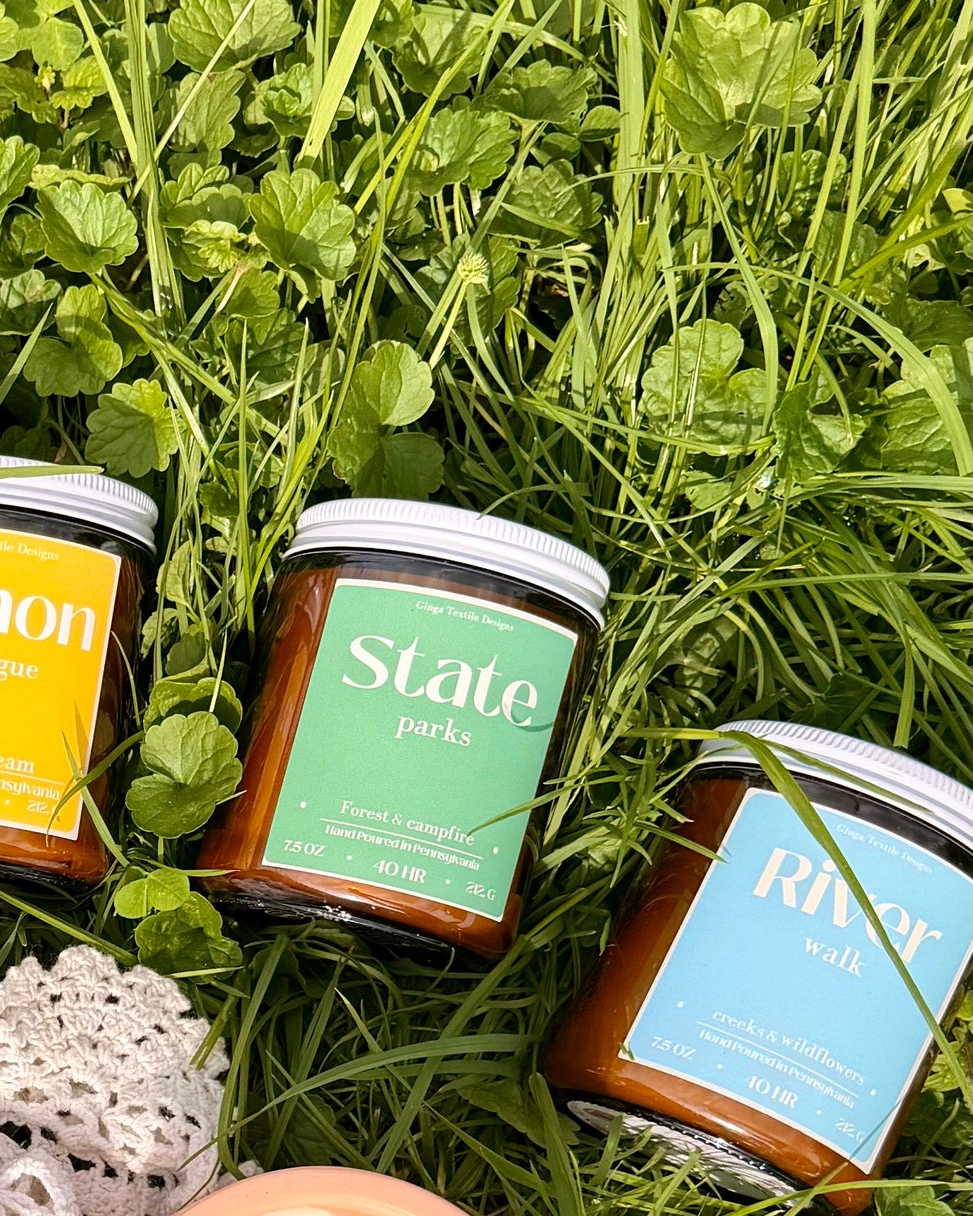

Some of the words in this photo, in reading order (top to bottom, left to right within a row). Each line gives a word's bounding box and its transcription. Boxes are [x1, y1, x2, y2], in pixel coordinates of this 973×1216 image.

[17, 542, 59, 561] Designs
[415, 600, 444, 615] Ginga
[446, 606, 479, 621] Textile
[481, 614, 514, 631] Designs
[341, 635, 538, 727] State
[394, 715, 472, 747] parks
[340, 800, 389, 823] Forest
[391, 813, 403, 826] &
[406, 819, 475, 846] campfire
[868, 835, 899, 856] Textile
[283, 839, 302, 853] 7.5
[303, 843, 326, 857] OZ
[372, 859, 400, 877] 40
[401, 864, 428, 885] HR
[487, 888, 496, 901] G
[324, 824, 357, 841] Hand
[356, 830, 401, 850] Poured
[412, 843, 480, 871] Pennsylvania
[753, 847, 943, 964] River
[804, 936, 866, 978] walk
[699, 1029, 733, 1049] Hand
[731, 1041, 777, 1068] Poured
[787, 1066, 855, 1109] Pennsylvania
[712, 1010, 765, 1038] creeks
[766, 1030, 779, 1043] &
[782, 1033, 866, 1086] wildflowers
[672, 1042, 697, 1061] OZ
[771, 1087, 799, 1109] HR
